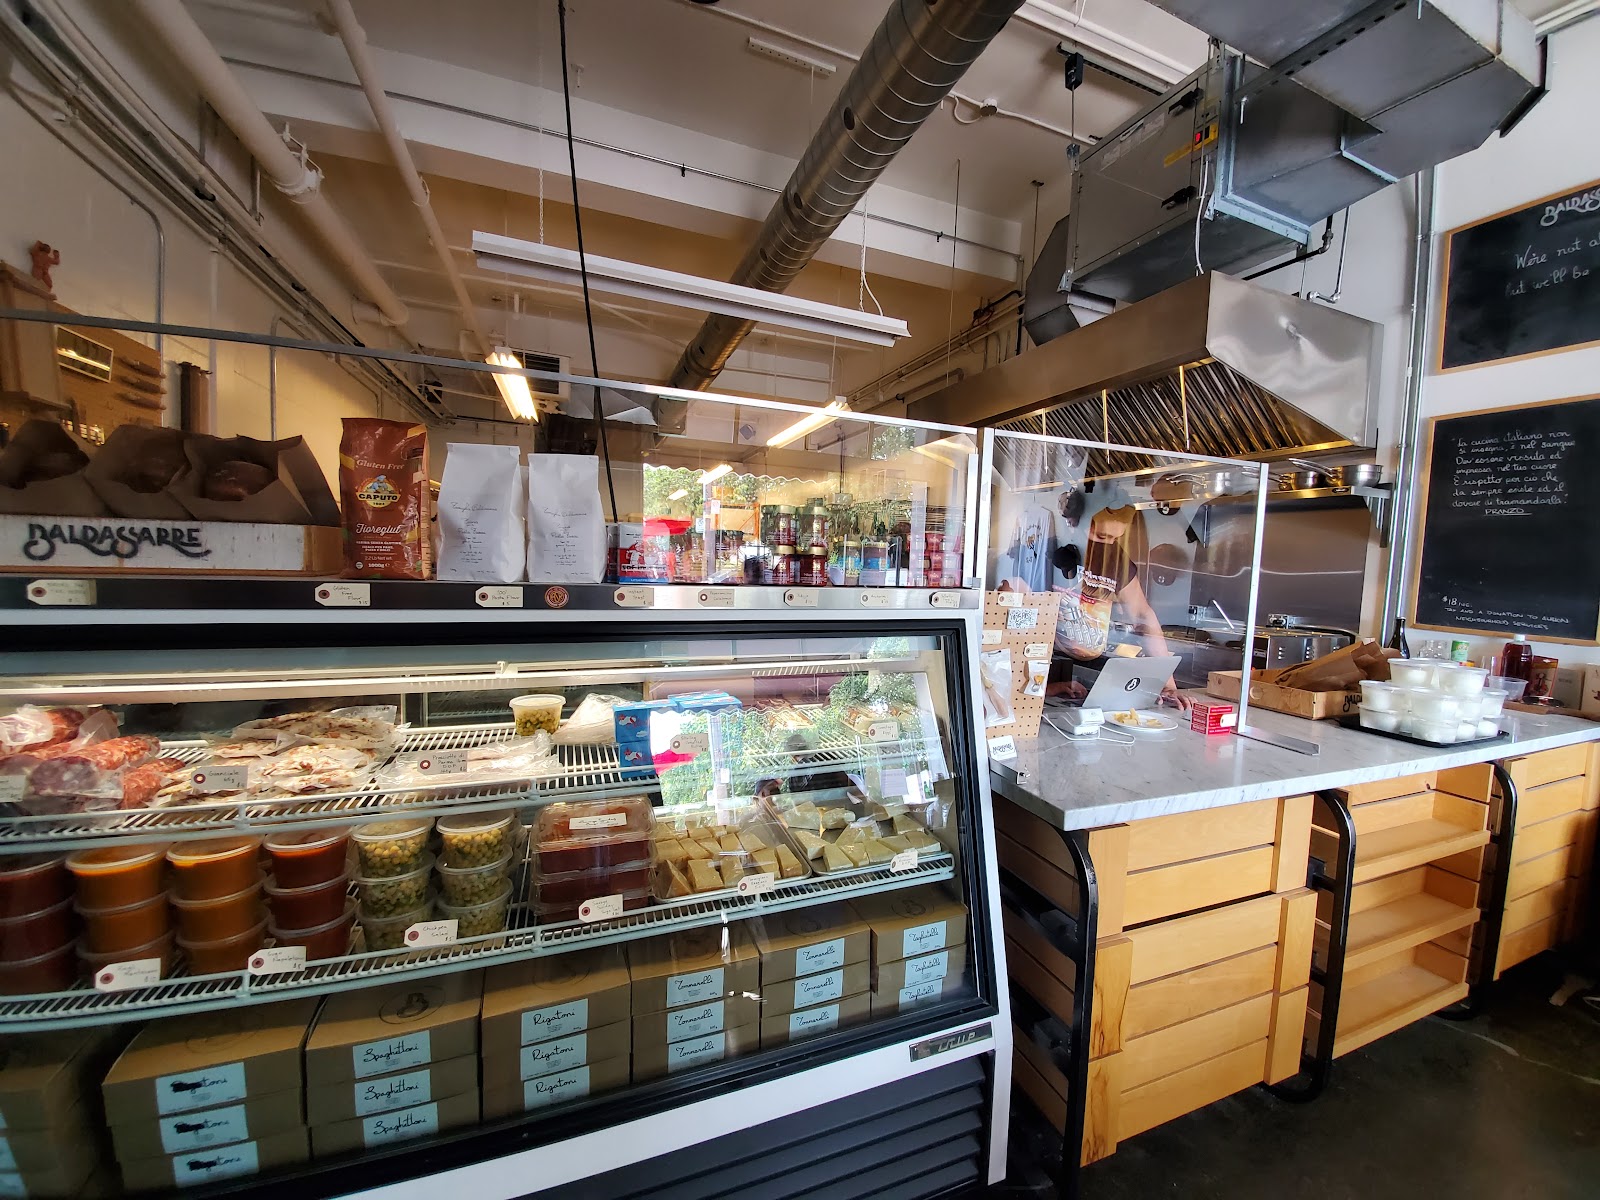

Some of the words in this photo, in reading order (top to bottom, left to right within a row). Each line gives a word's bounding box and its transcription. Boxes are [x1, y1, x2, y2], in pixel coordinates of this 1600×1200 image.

[1557, 238, 1582, 257] not
[1573, 265, 1590, 279] be
[1548, 431, 1571, 439] non
[1520, 440, 1538, 450] nel
[1550, 450, 1563, 460] ed
[356, 459, 386, 470] Gluten
[1541, 471, 1560, 483] che
[358, 493, 398, 501] CAPUTO
[1471, 487, 1503, 498] sempre
[1484, 507, 1525, 516] PRANZO
[23, 522, 212, 561] BALDASSARRE
[533, 1008, 576, 1026] Rigatoni
[363, 1040, 420, 1063] Spaghettoni
[532, 1044, 574, 1062] Rigatoni
[364, 1079, 420, 1101] Spaghettoni
[535, 1075, 577, 1094] Rigatoni
[373, 1112, 428, 1135] Spaghettoni
